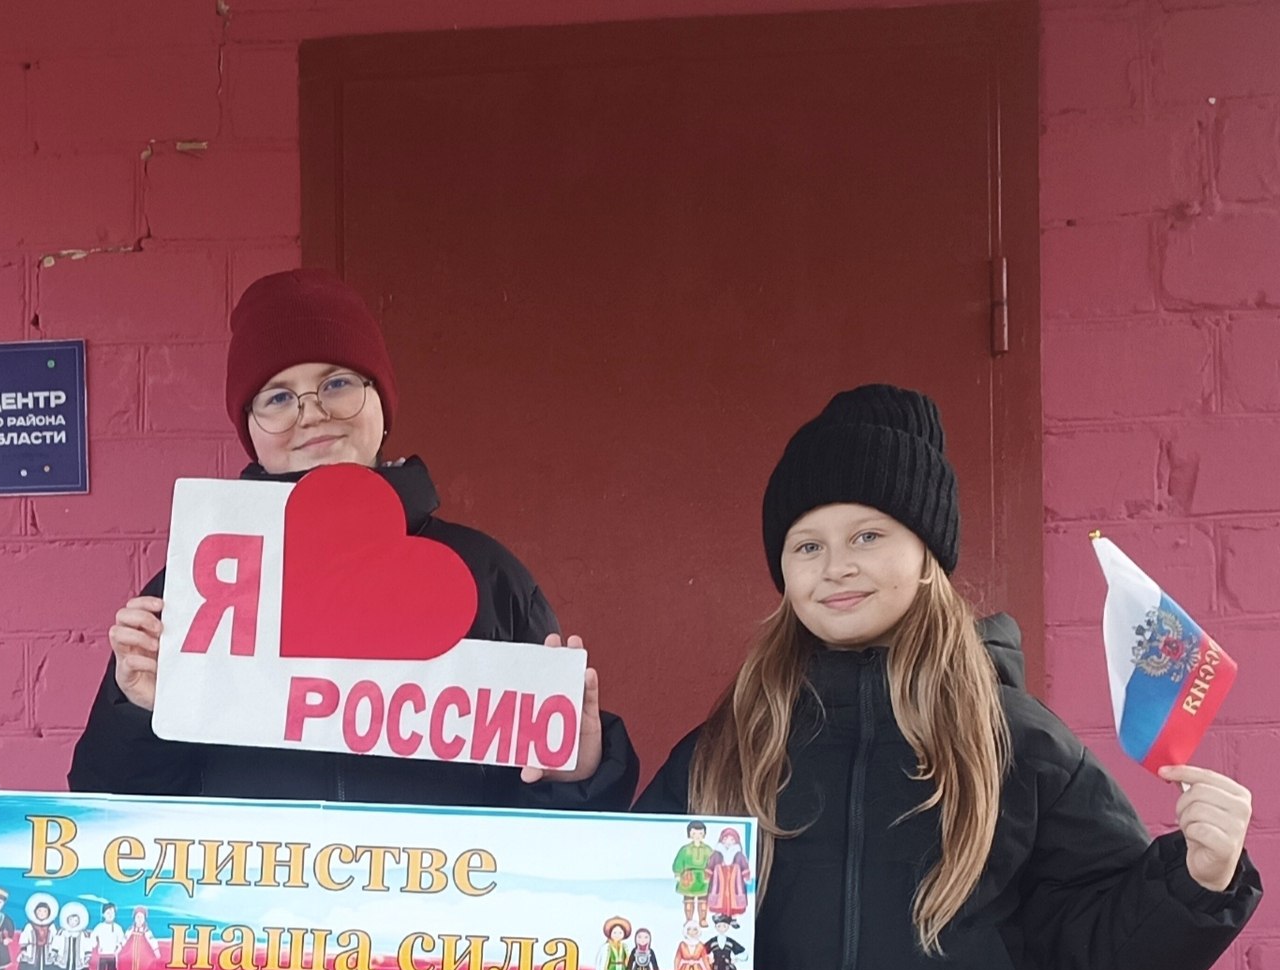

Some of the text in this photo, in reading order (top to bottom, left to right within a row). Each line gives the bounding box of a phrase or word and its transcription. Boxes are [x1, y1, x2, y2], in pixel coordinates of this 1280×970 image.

[7, 414, 66, 428] РАЙОНА
[180, 533, 264, 657] Я
[283, 676, 577, 770] РОССИЮ
[22, 814, 497, 898] В единстве
